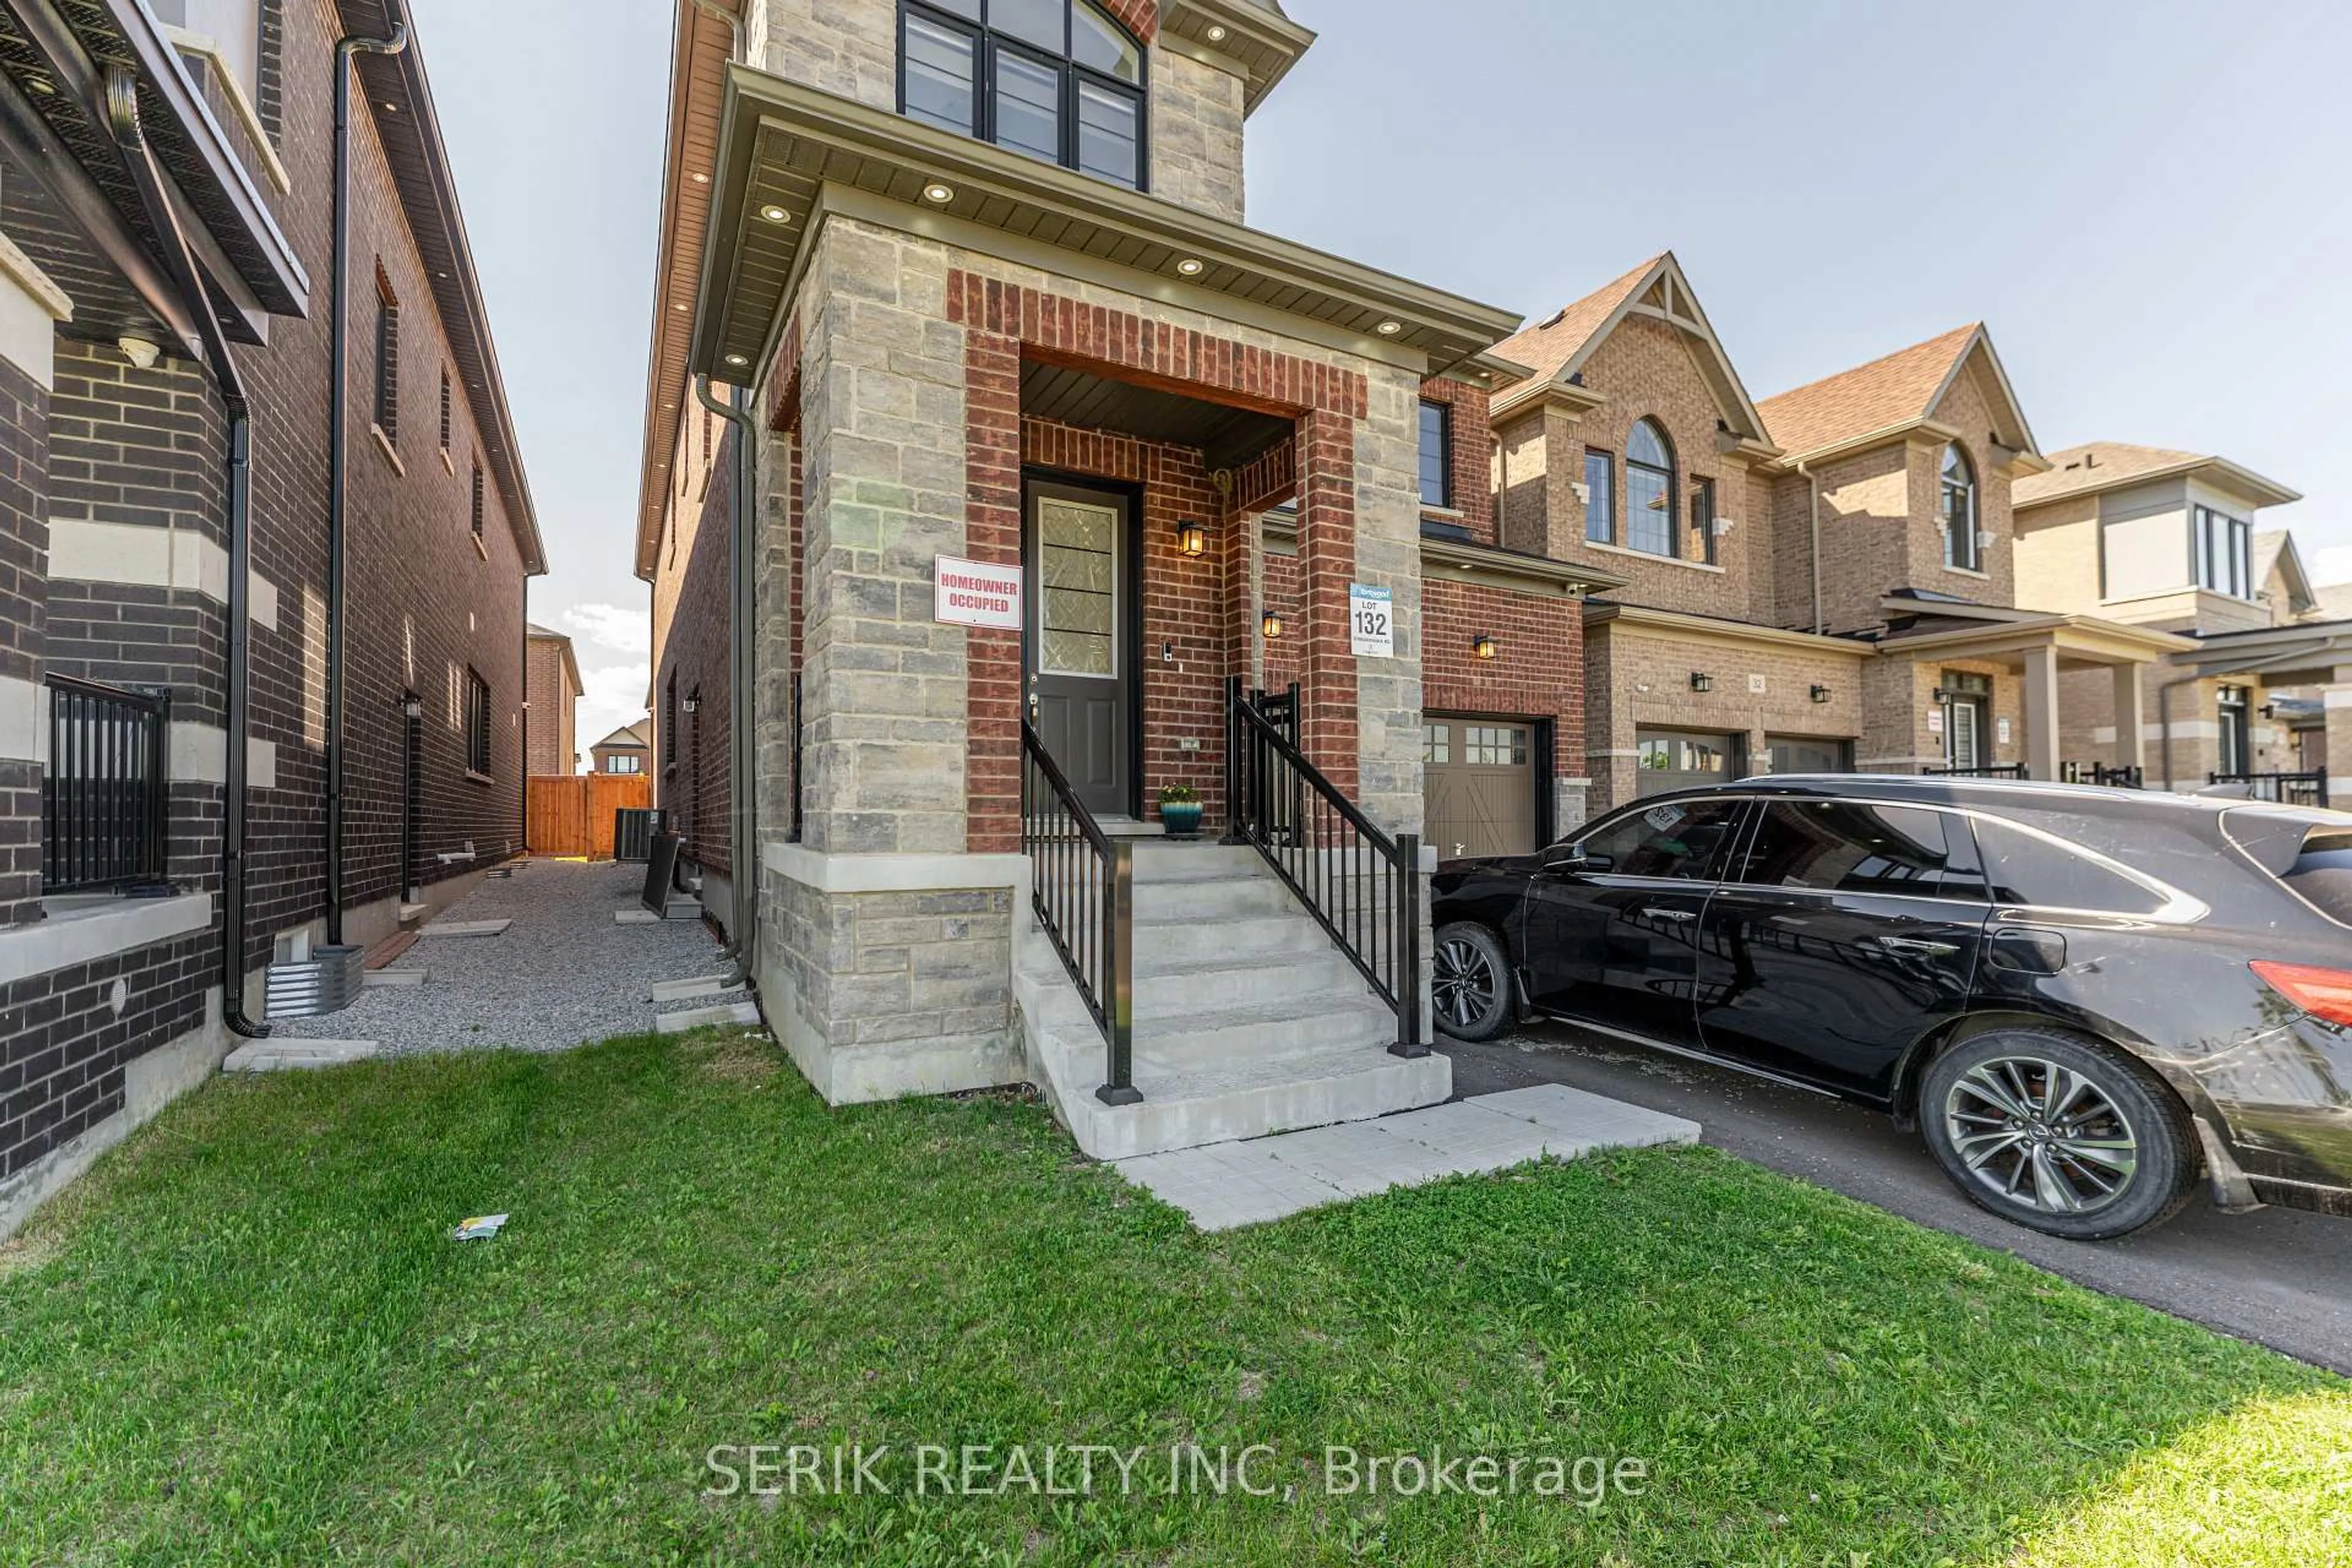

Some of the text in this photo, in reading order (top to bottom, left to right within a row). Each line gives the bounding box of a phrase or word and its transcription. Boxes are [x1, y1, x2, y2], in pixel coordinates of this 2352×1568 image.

[941, 573, 1017, 595] HOMEOWNER
[949, 593, 1009, 612] OCCUPIED
[1362, 601, 1378, 609] LOT
[1355, 611, 1386, 636] 132
